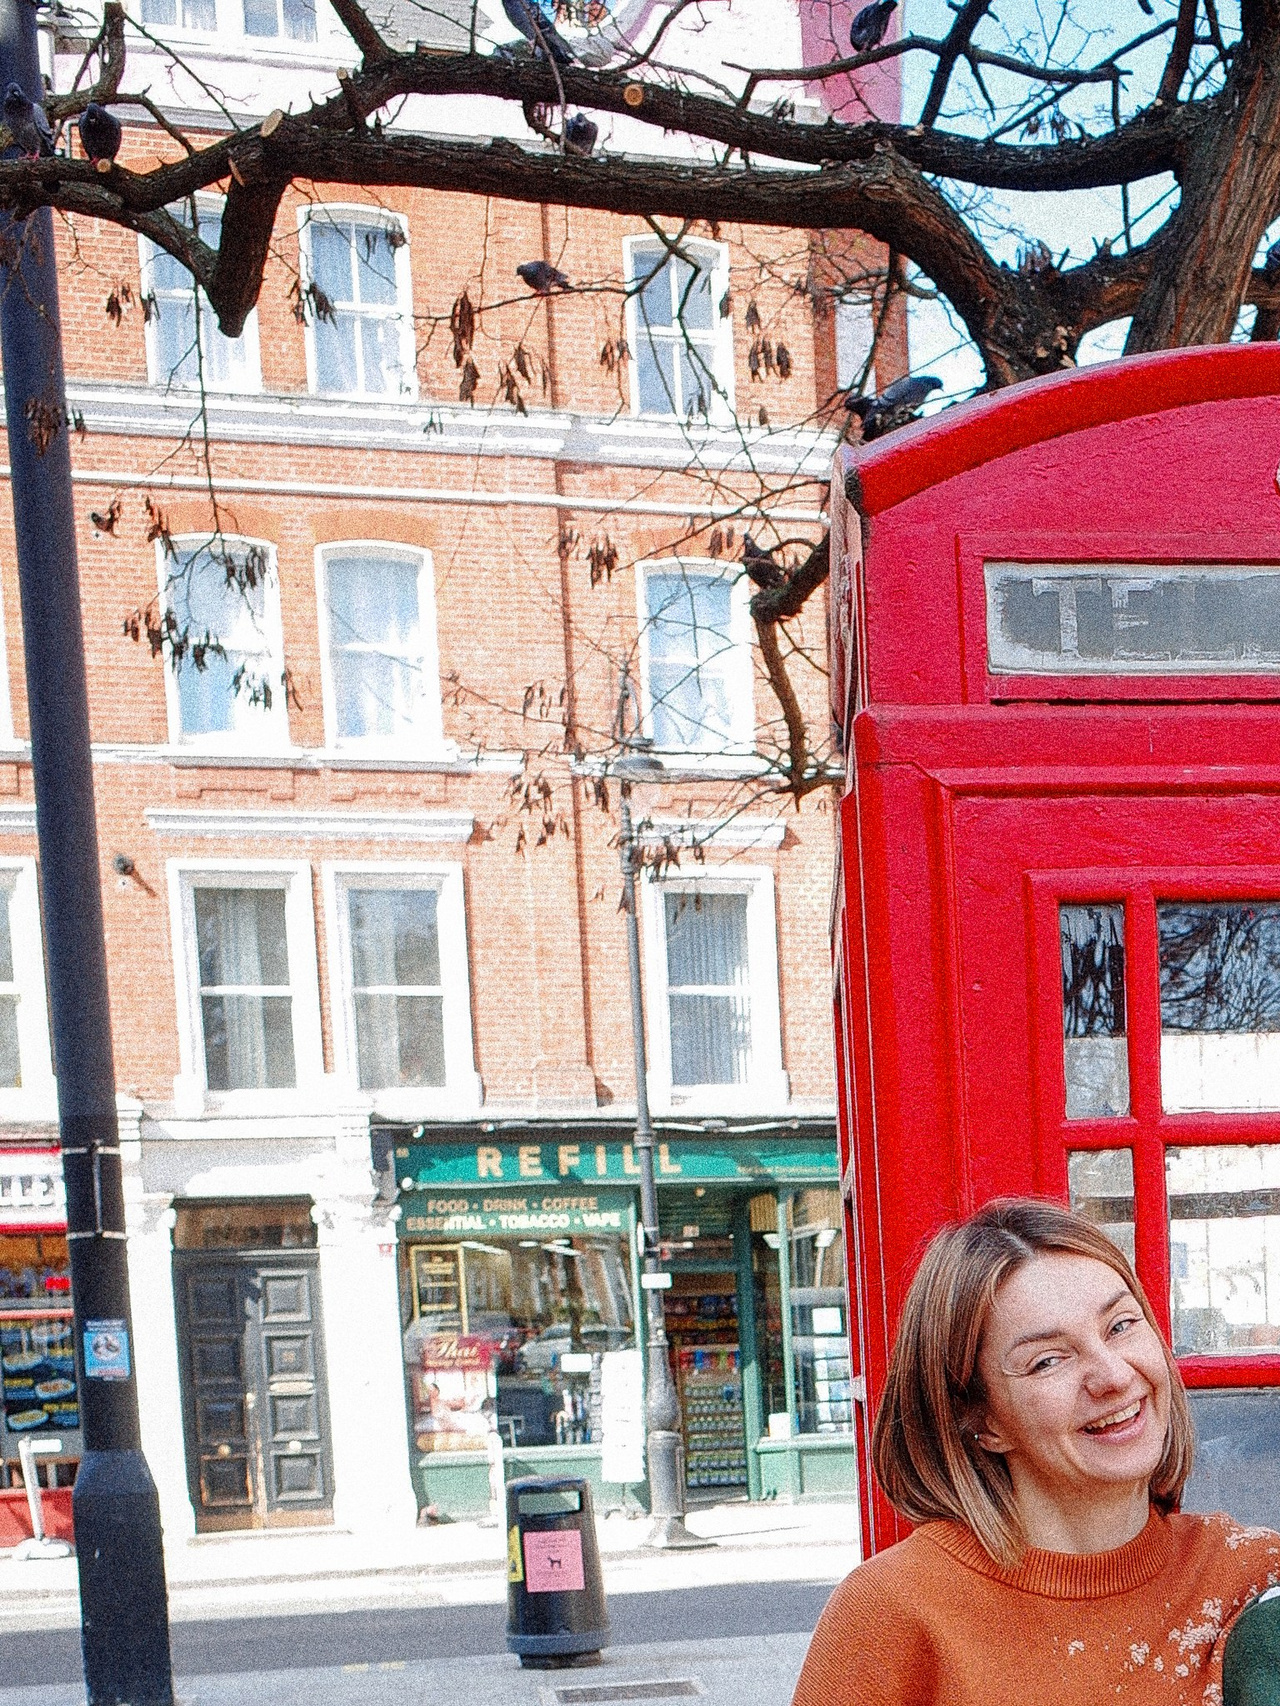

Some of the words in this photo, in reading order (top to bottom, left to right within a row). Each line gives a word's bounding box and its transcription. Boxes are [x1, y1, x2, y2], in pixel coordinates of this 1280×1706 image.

[476, 1143, 682, 1178] REFILL
[428, 1200, 469, 1214] FOOD
[484, 1199, 528, 1212] DRINK
[542, 1196, 598, 1211] COFFEE
[407, 1216, 486, 1231] ESSENTIAL
[499, 1214, 570, 1229] TOBACCO
[583, 1213, 621, 1227] VAPE
